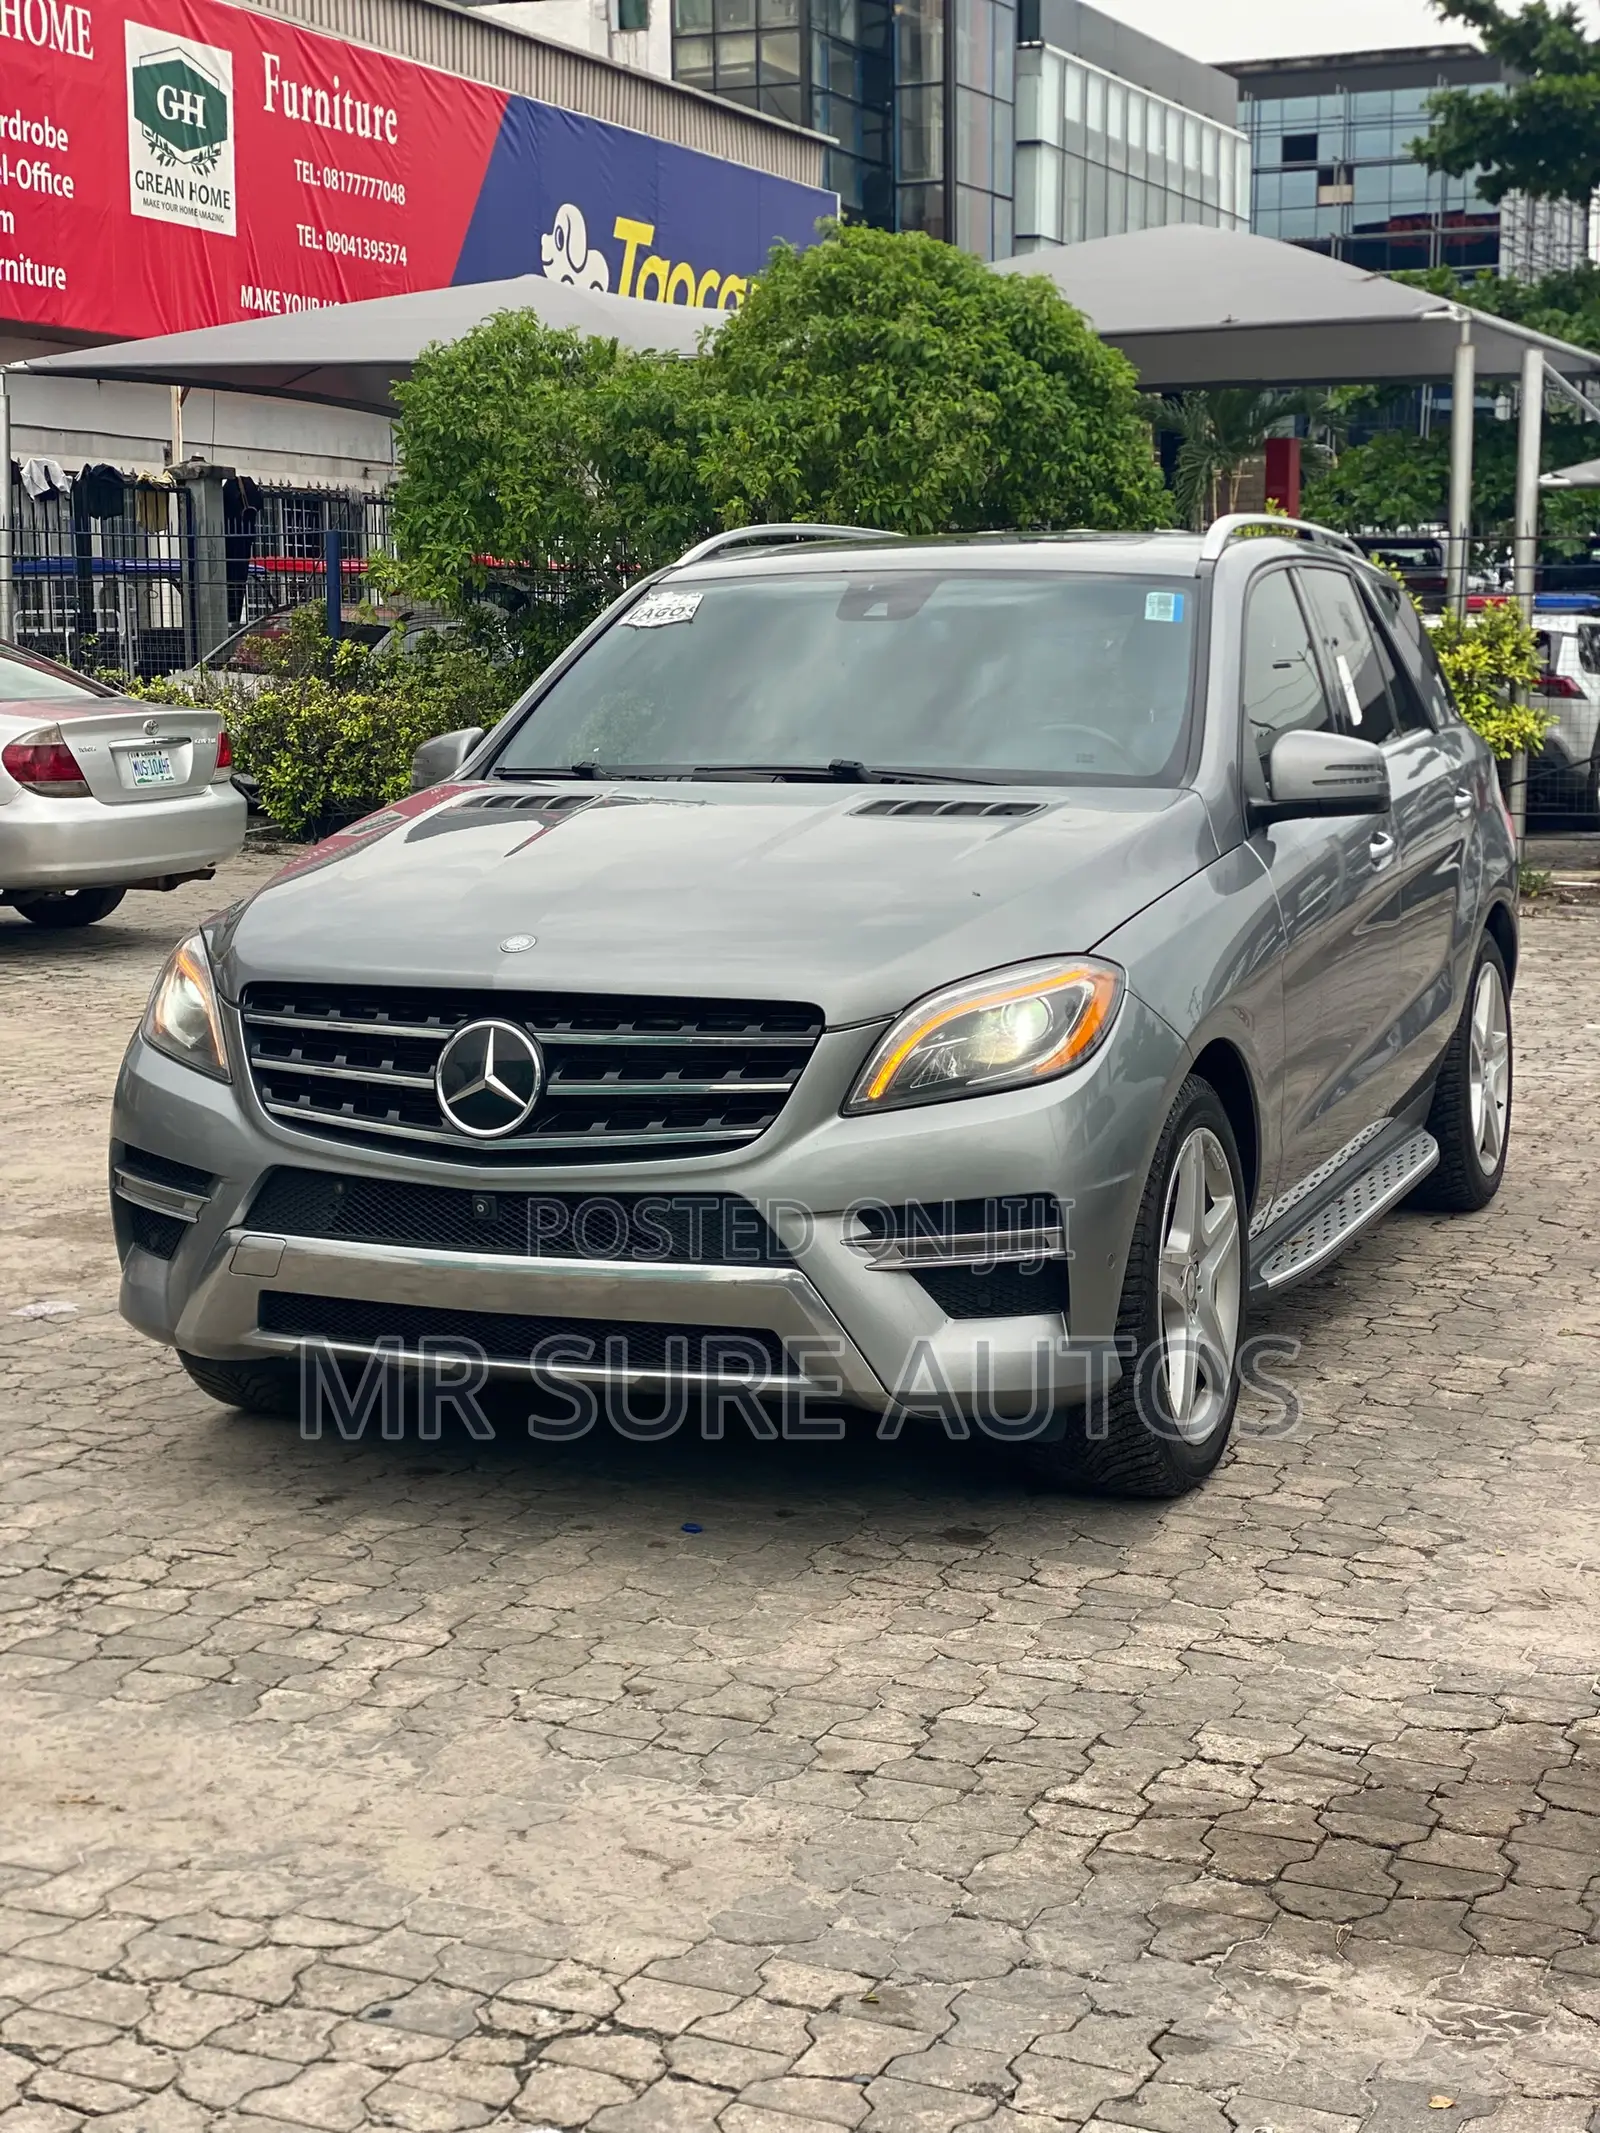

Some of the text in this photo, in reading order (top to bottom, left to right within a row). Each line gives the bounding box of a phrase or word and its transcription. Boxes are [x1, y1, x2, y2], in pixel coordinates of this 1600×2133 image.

[0, 0, 94, 60] HOME
[156, 84, 206, 129] GH
[261, 51, 398, 145] Furniture
[0, 153, 75, 199] l-Office
[135, 169, 231, 211] GREAN HOME
[294, 158, 406, 206] TEL: 08177777048
[142, 197, 161, 210] MAKE
[161, 201, 179, 212] YOUR
[180, 205, 199, 217] HOME
[296, 223, 408, 267] TEL: 09041395374
[240, 284, 281, 314] MAKE
